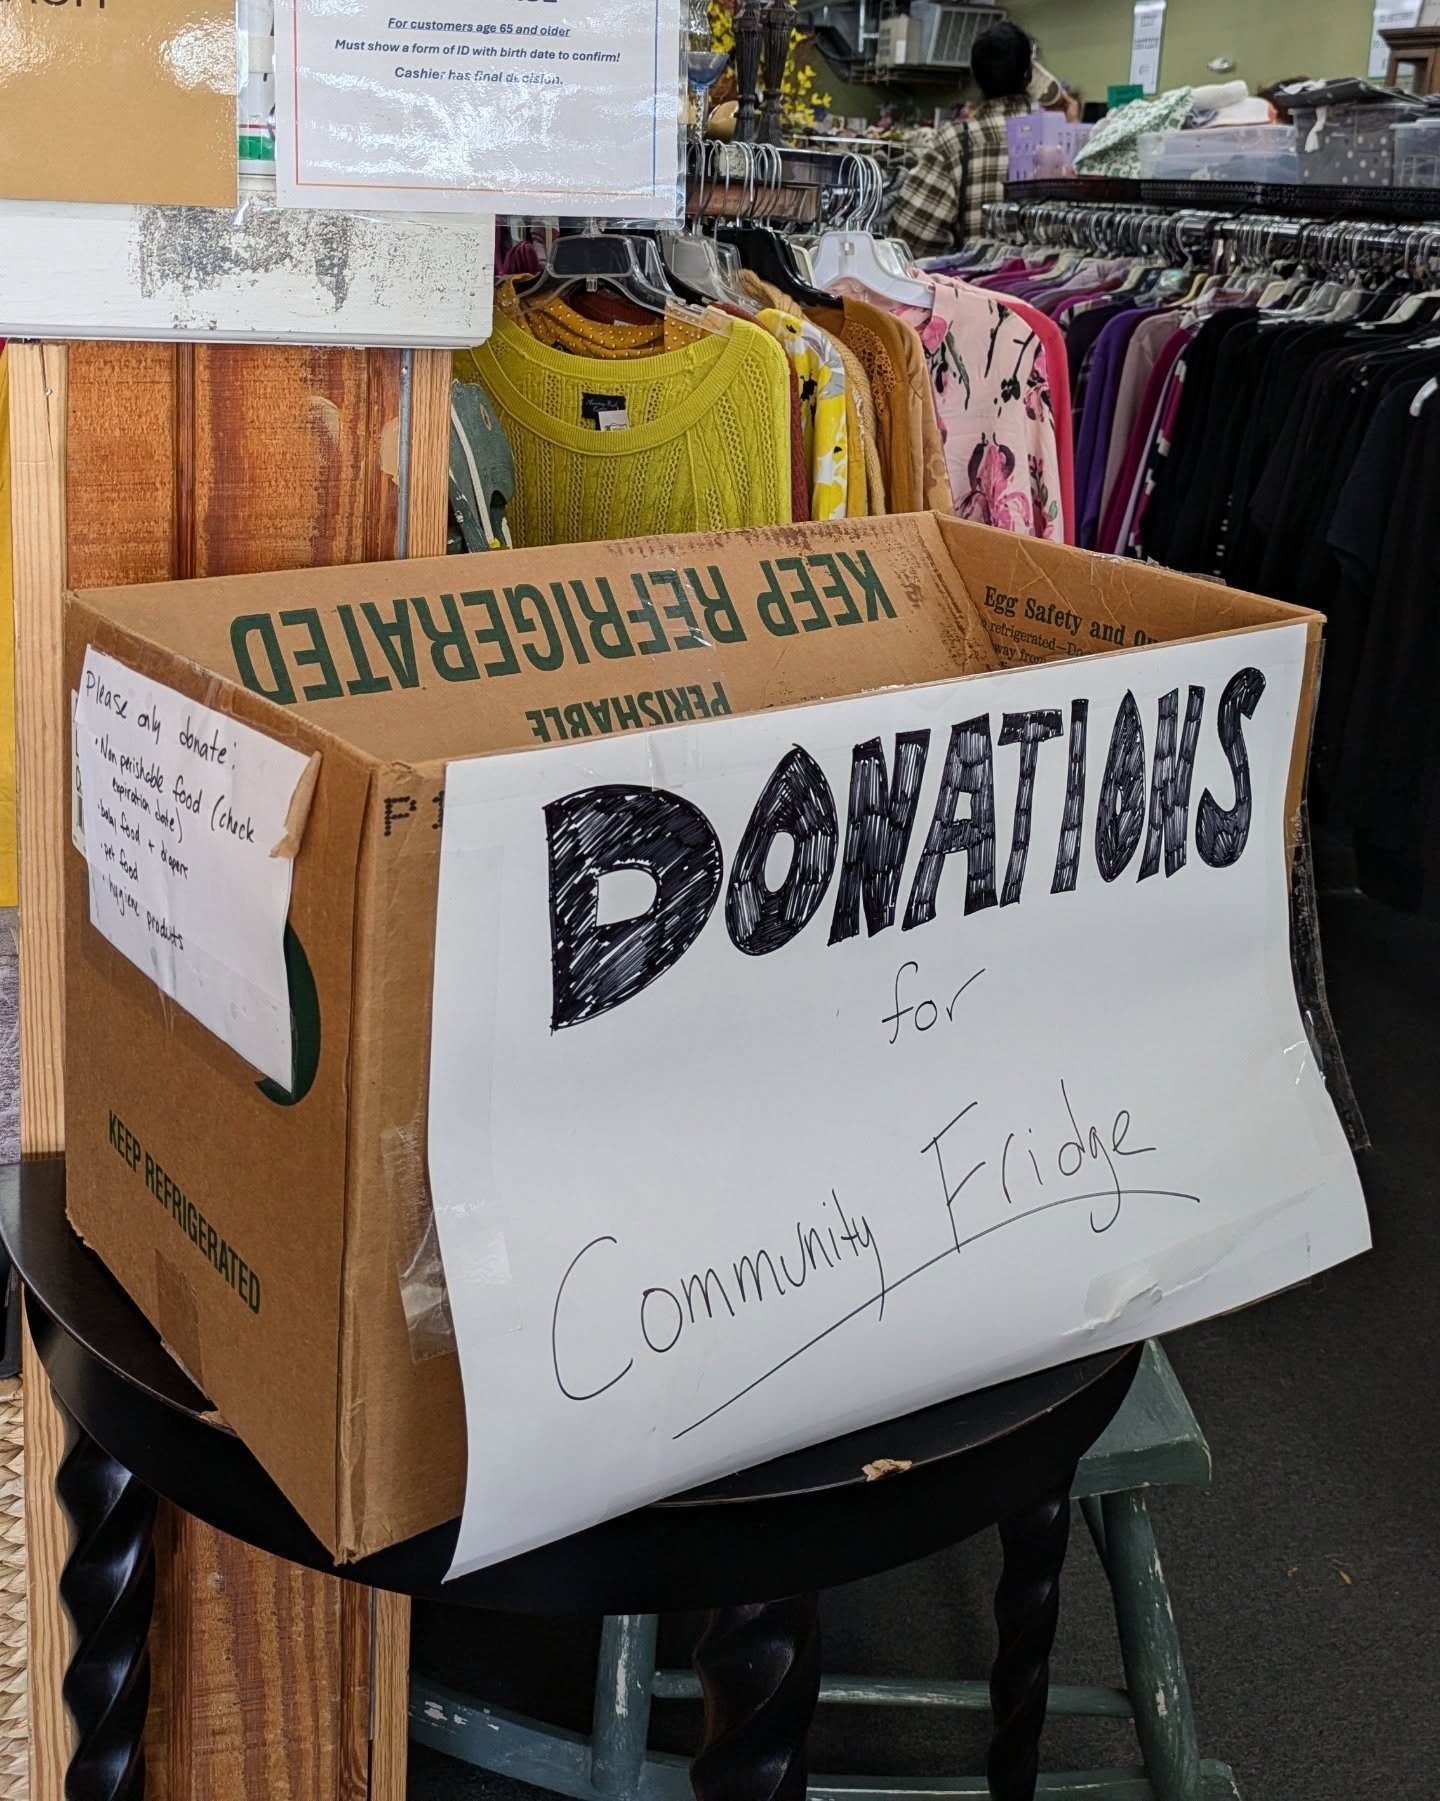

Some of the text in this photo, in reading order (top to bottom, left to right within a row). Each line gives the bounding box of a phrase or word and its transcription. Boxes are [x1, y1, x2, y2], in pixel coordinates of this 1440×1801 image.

[335, 39, 620, 63] Must show a form of ID with birth date to confirm!
[388, 17, 570, 37] For customers age 65 and older
[395, 67, 446, 80] Cashier
[448, 69, 471, 81] has
[474, 71, 502, 83] final
[230, 550, 898, 706] KEEP REFRIGERATED
[984, 585, 1018, 618] Egg
[1024, 597, 1083, 636] Safety
[1090, 621, 1126, 647] and
[86, 670, 237, 770] Please only donate:
[524, 681, 733, 742] PERISHABLE
[100, 798, 117, 835] baby
[120, 811, 140, 845] food
[112, 777, 183, 843] expiration date)
[120, 756, 163, 793] perishable
[172, 774, 202, 814] food
[211, 795, 255, 843] (check
[104, 843, 138, 882] pet food
[543, 666, 1266, 1034] DONATIONS
[108, 873, 139, 916] hygiene
[882, 962, 986, 1044] for
[109, 1109, 261, 1314] KEEP REFRIGERATED
[552, 1079, 1156, 1400] Community Fridge
